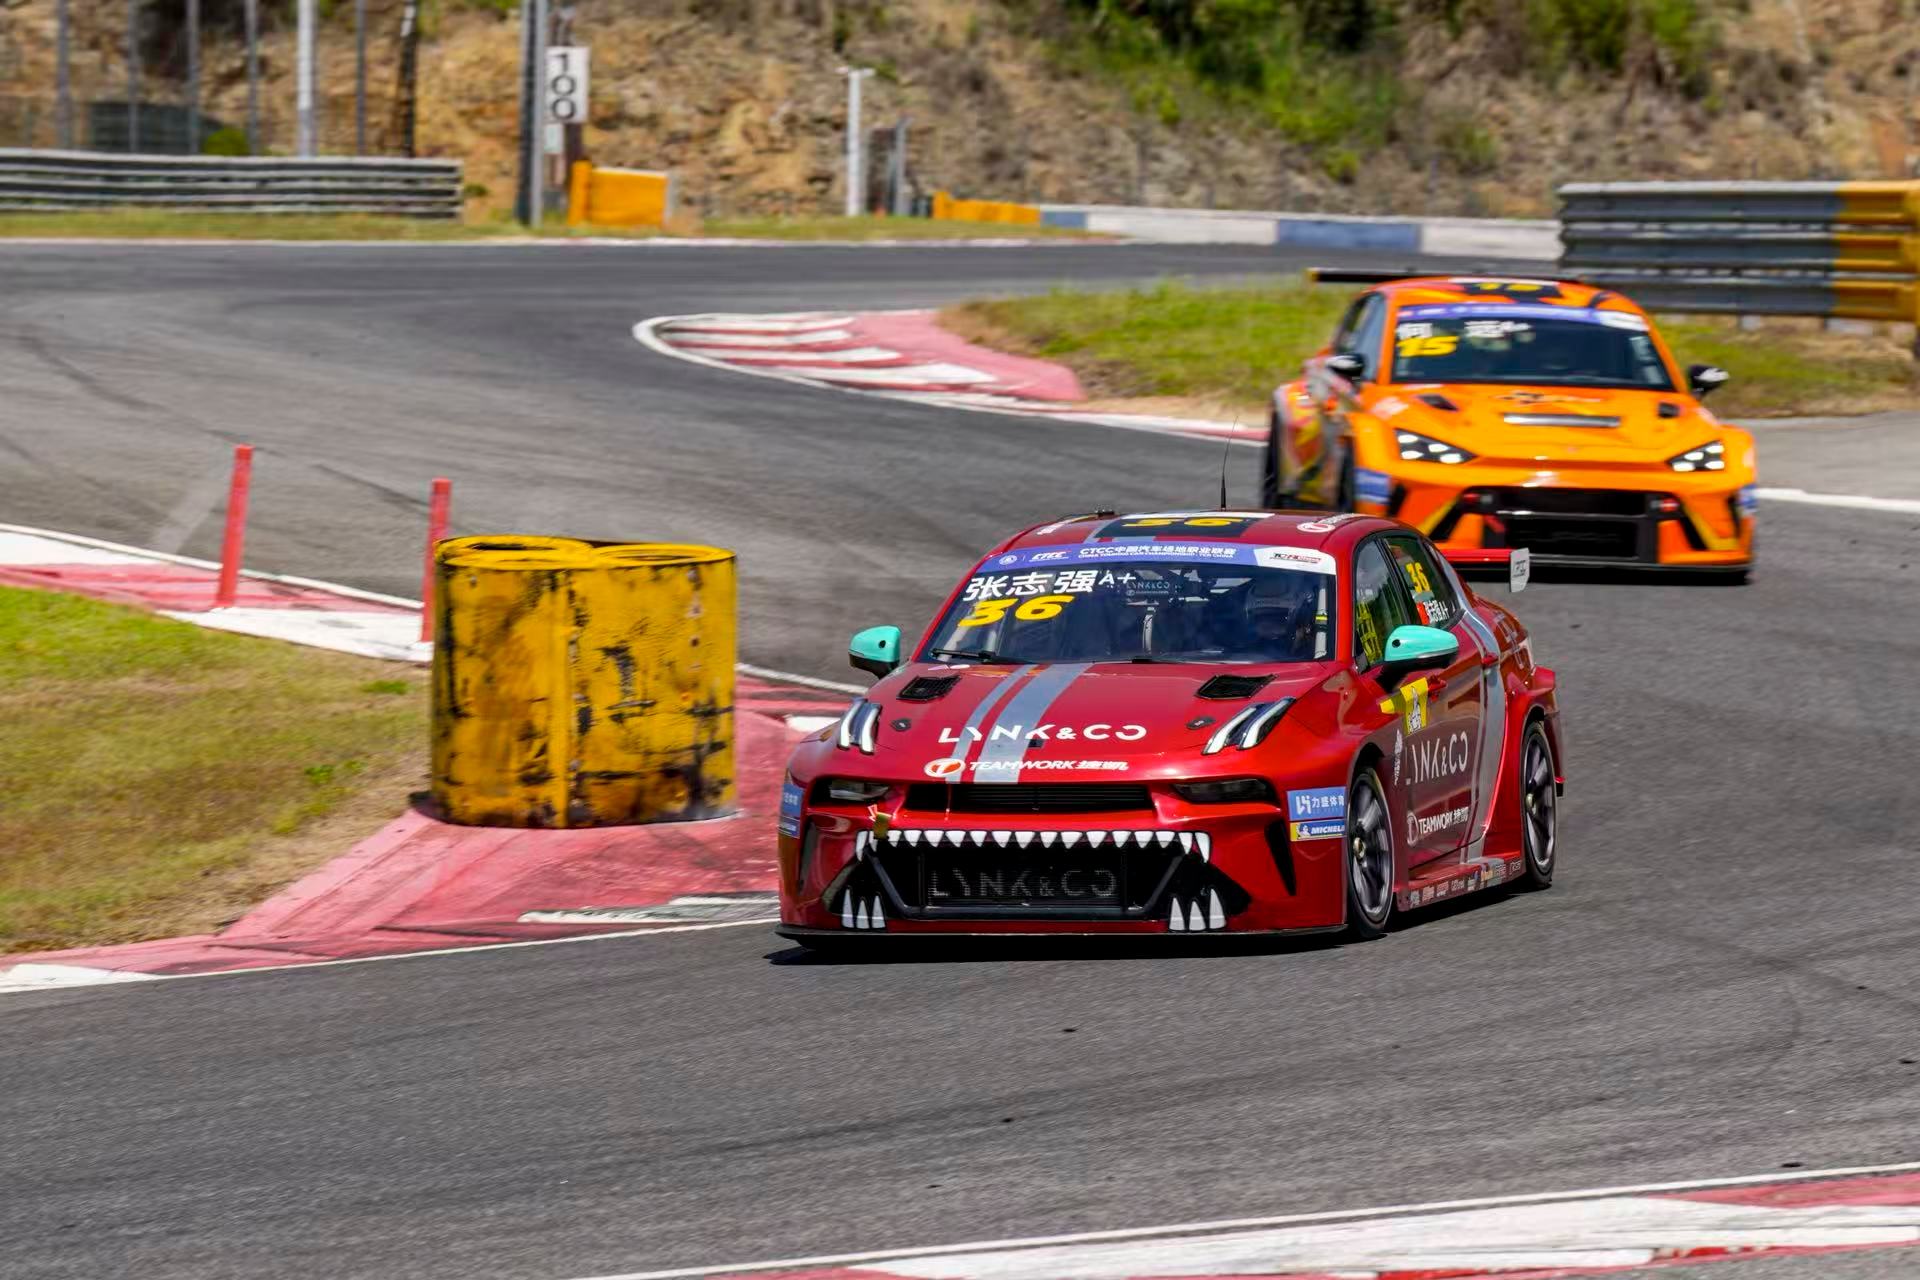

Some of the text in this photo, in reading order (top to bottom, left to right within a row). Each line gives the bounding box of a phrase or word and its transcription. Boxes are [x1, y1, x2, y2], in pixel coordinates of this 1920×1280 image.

[550, 53, 576, 120] 100
[1396, 335, 1459, 357] 15
[962, 570, 1136, 601] 张志强 A+
[1405, 562, 1430, 594] 36
[957, 594, 1075, 627] 36
[969, 760, 1075, 771] TEAMWORK
[1418, 811, 1454, 835] TEAMWORK
